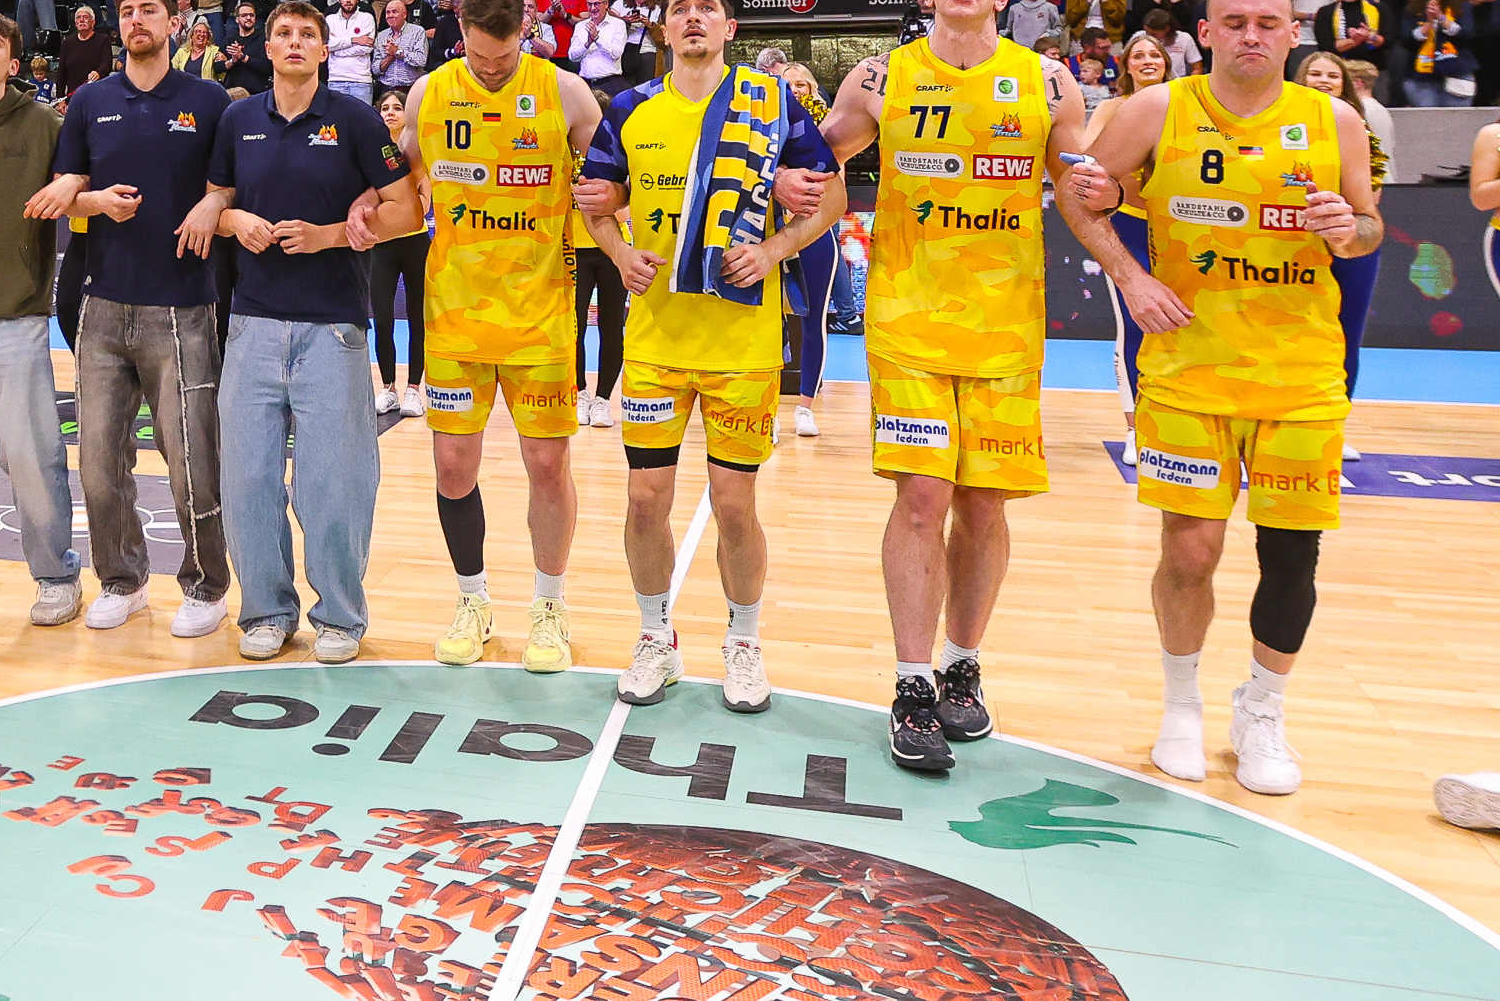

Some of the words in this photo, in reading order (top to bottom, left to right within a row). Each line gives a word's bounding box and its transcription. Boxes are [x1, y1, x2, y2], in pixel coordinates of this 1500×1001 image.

[909, 105, 952, 139] 77
[444, 119, 471, 150] 10
[635, 142, 659, 150] CRAFT
[499, 167, 550, 185] REWE
[975, 157, 1032, 177] REWE
[1200, 149, 1224, 185] 8
[938, 205, 1020, 230] Thalia
[1222, 256, 1315, 285] Thalia
[522, 393, 568, 409] mark
[710, 409, 756, 434] mark
[895, 432, 929, 446] federn
[980, 436, 1033, 457] mark
[1139, 450, 1218, 476] platzmann
[1156, 469, 1192, 485] federn
[1253, 470, 1320, 494] mark
[189, 690, 904, 821] Thalia
